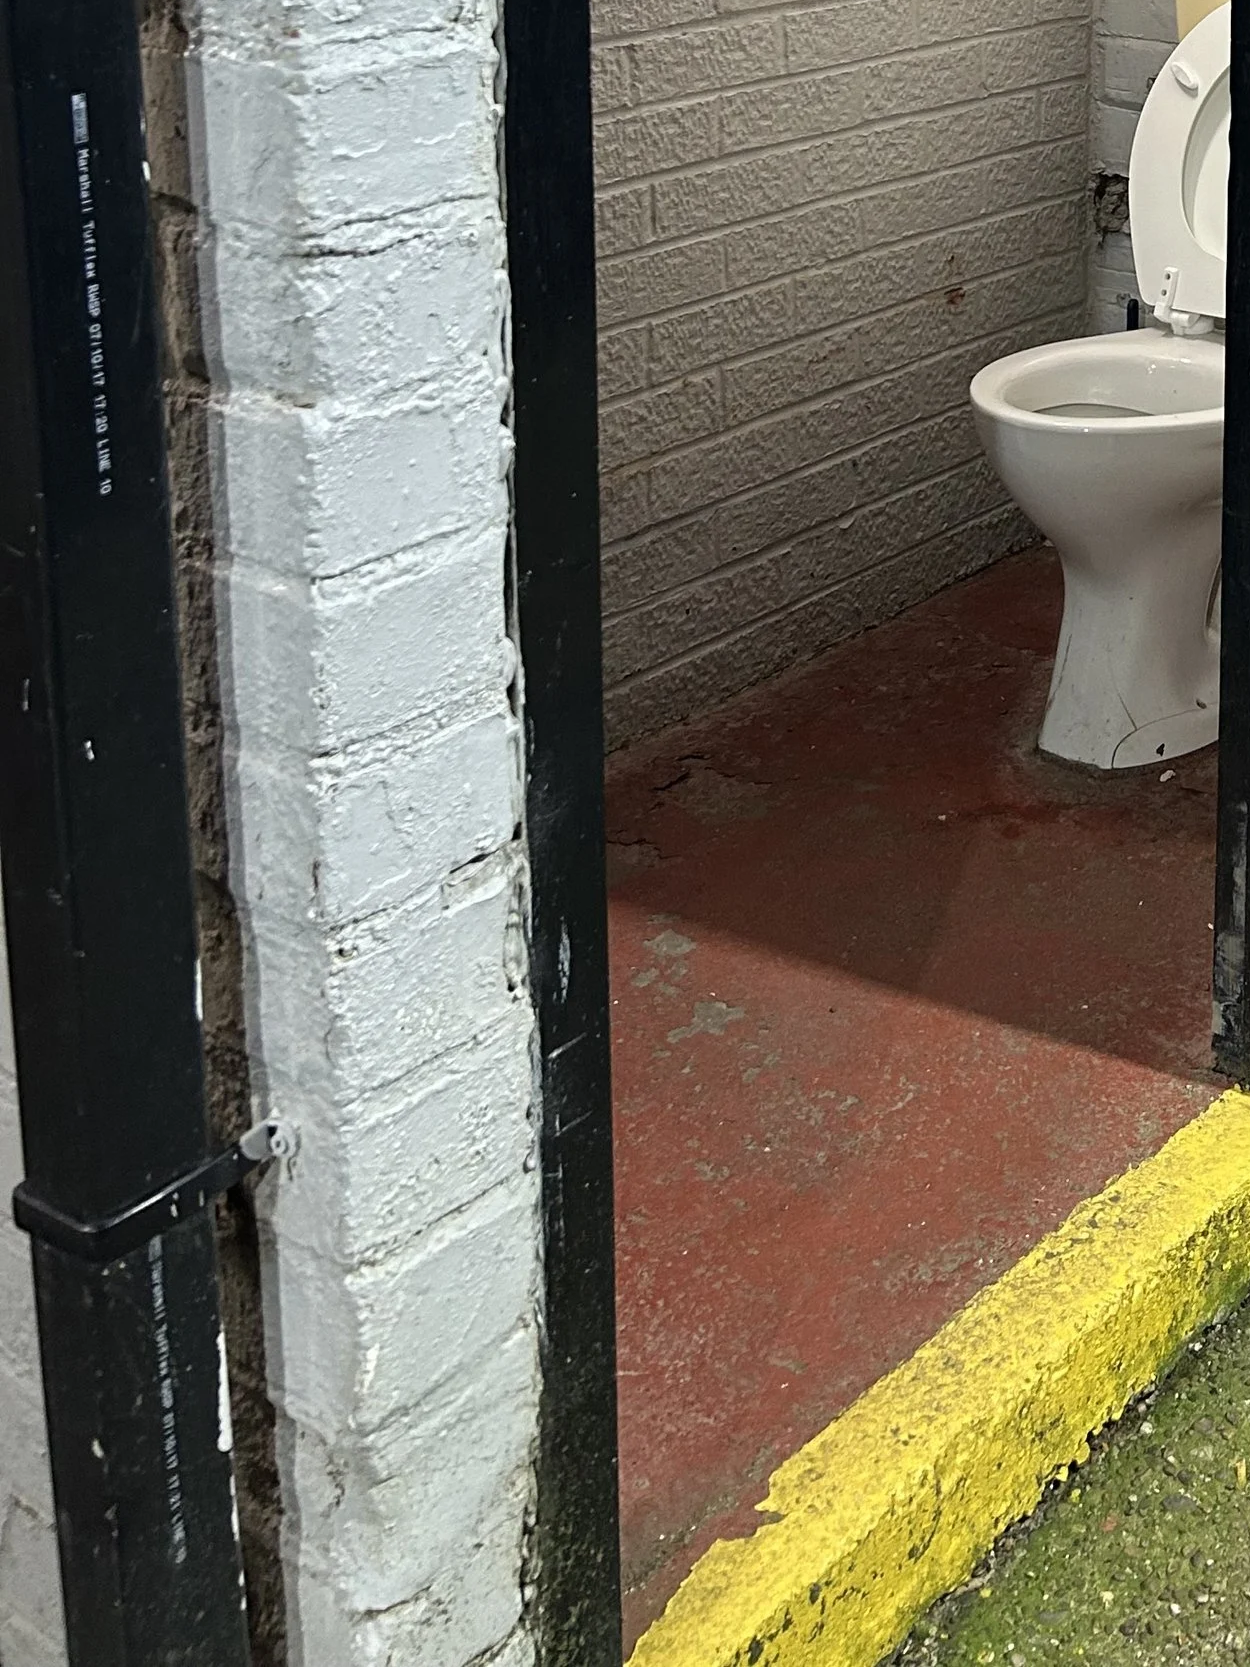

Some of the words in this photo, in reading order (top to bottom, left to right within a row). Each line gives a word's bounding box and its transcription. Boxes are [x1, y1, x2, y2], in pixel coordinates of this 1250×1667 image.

[77, 148, 93, 213] Marshall
[82, 220, 97, 279] Tufflex
[89, 323, 105, 386] 07/10/17
[94, 394, 108, 434] 17:20
[97, 438, 112, 473] LINE
[100, 478, 112, 495] 10
